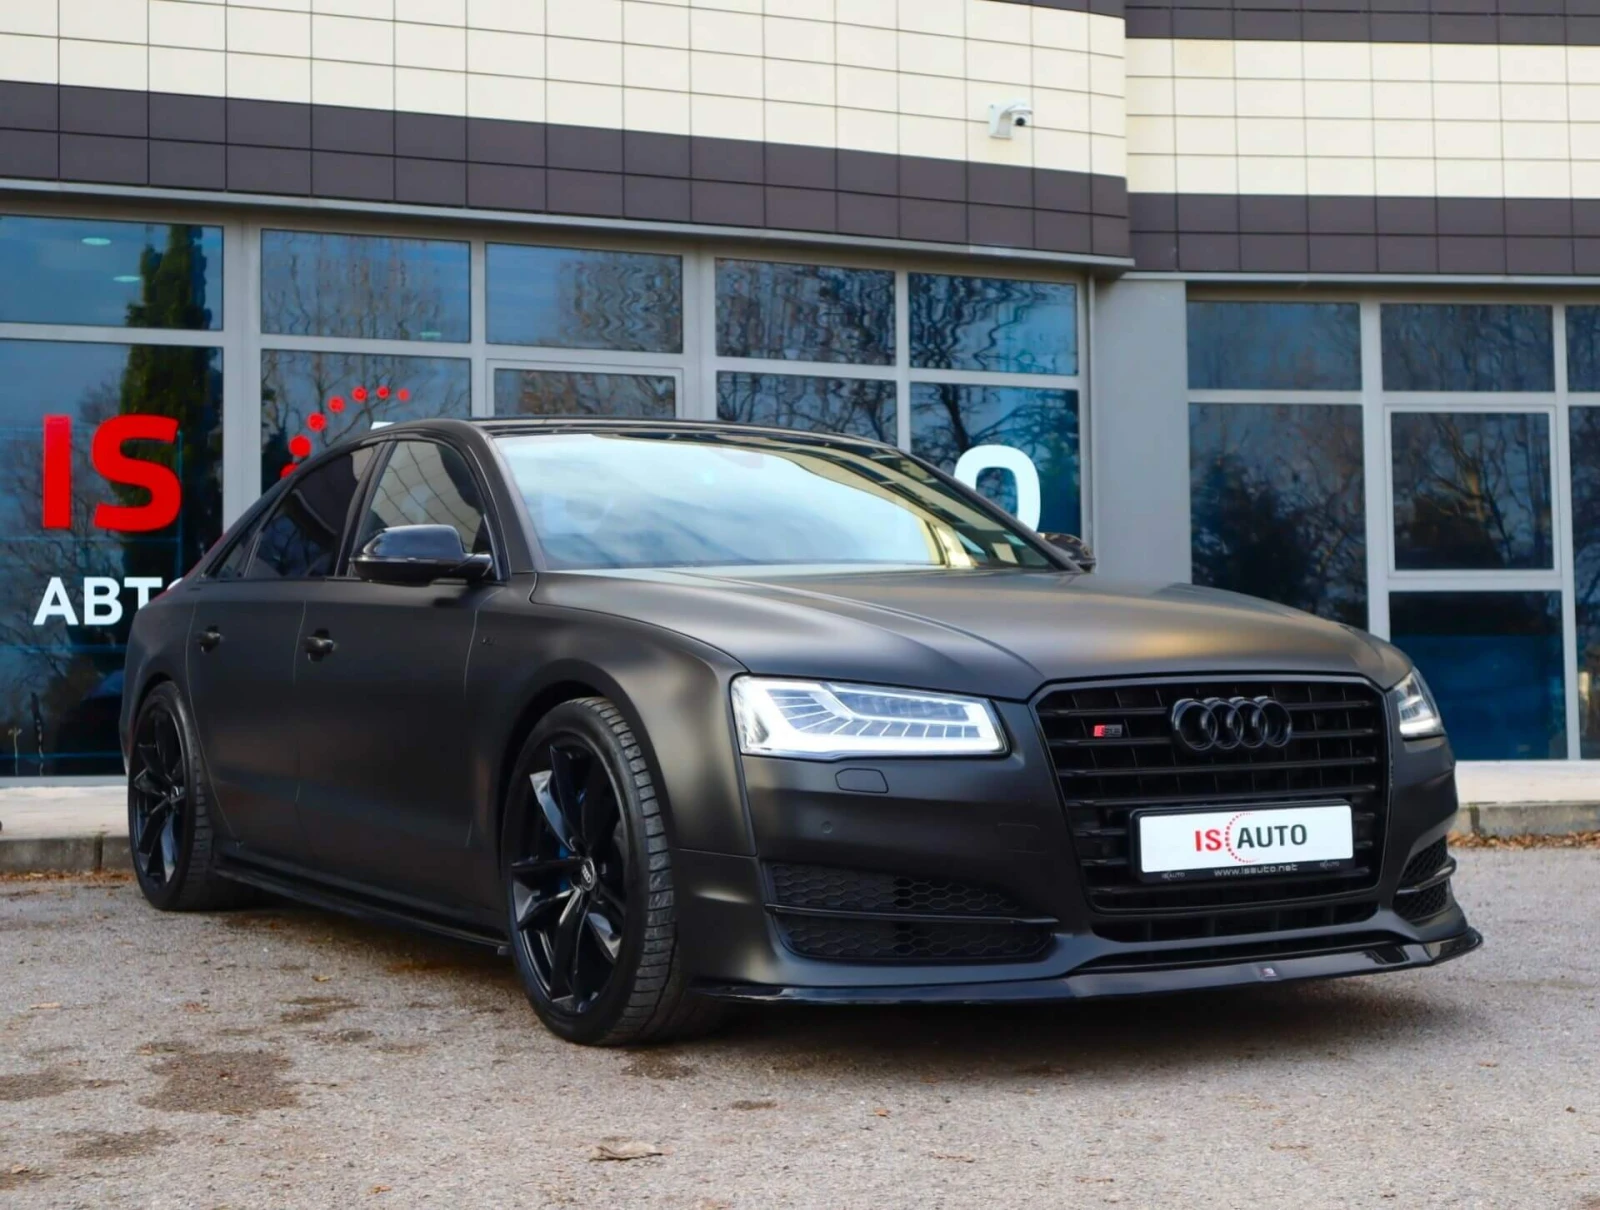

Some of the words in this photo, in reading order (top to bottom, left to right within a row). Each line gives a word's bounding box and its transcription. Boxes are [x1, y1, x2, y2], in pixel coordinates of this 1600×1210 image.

[43, 414, 182, 532] IS
[33, 576, 183, 626] АВТ
[1195, 829, 1222, 852] IS
[1237, 824, 1307, 849] AUTO
